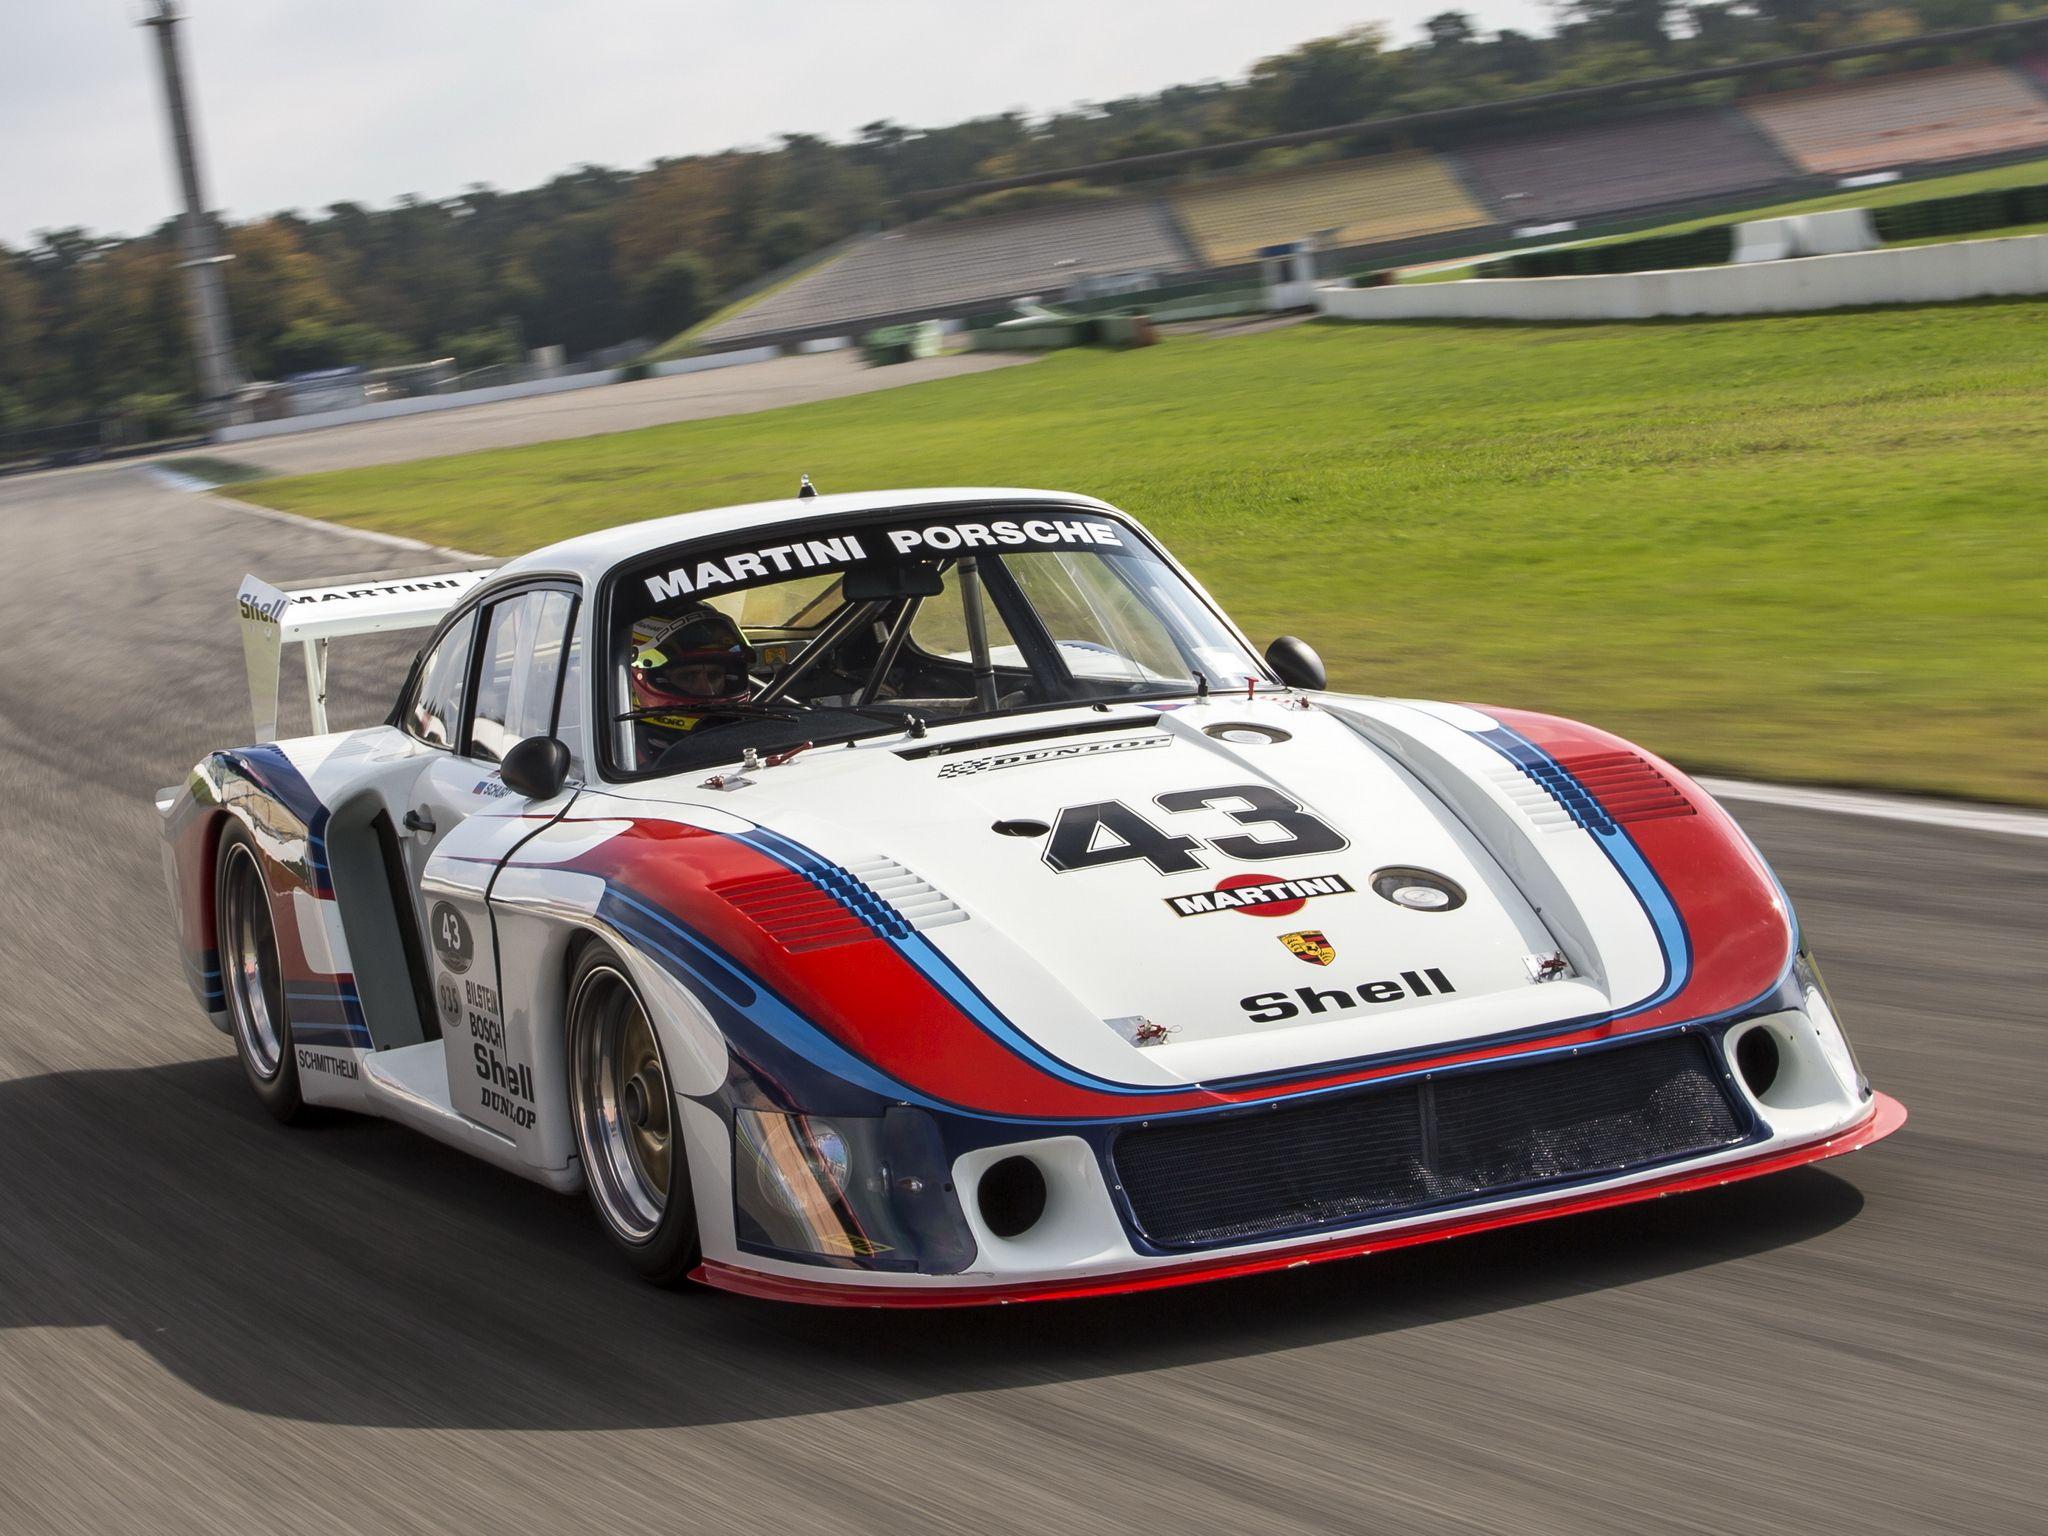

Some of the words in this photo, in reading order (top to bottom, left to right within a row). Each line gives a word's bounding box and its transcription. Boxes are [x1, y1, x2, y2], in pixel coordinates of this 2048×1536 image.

[643, 535, 868, 603] MARTINI
[887, 520, 1124, 554] PORSCHE
[239, 593, 288, 624] Shell
[290, 580, 461, 605] MARTINI
[993, 738, 1170, 766] DUNLOP
[1040, 783, 1352, 877] 43
[1172, 876, 1346, 915] MARTINI
[441, 912, 462, 950] 43
[440, 983, 460, 1015] 935
[465, 979, 499, 1016] BILSTEIN
[1239, 967, 1457, 1024] Shell
[468, 1011, 503, 1050] BOSCH
[298, 1049, 359, 1081] SCHMITTHELM
[473, 1042, 535, 1104] Shell
[481, 1086, 537, 1130] DUNLOP
